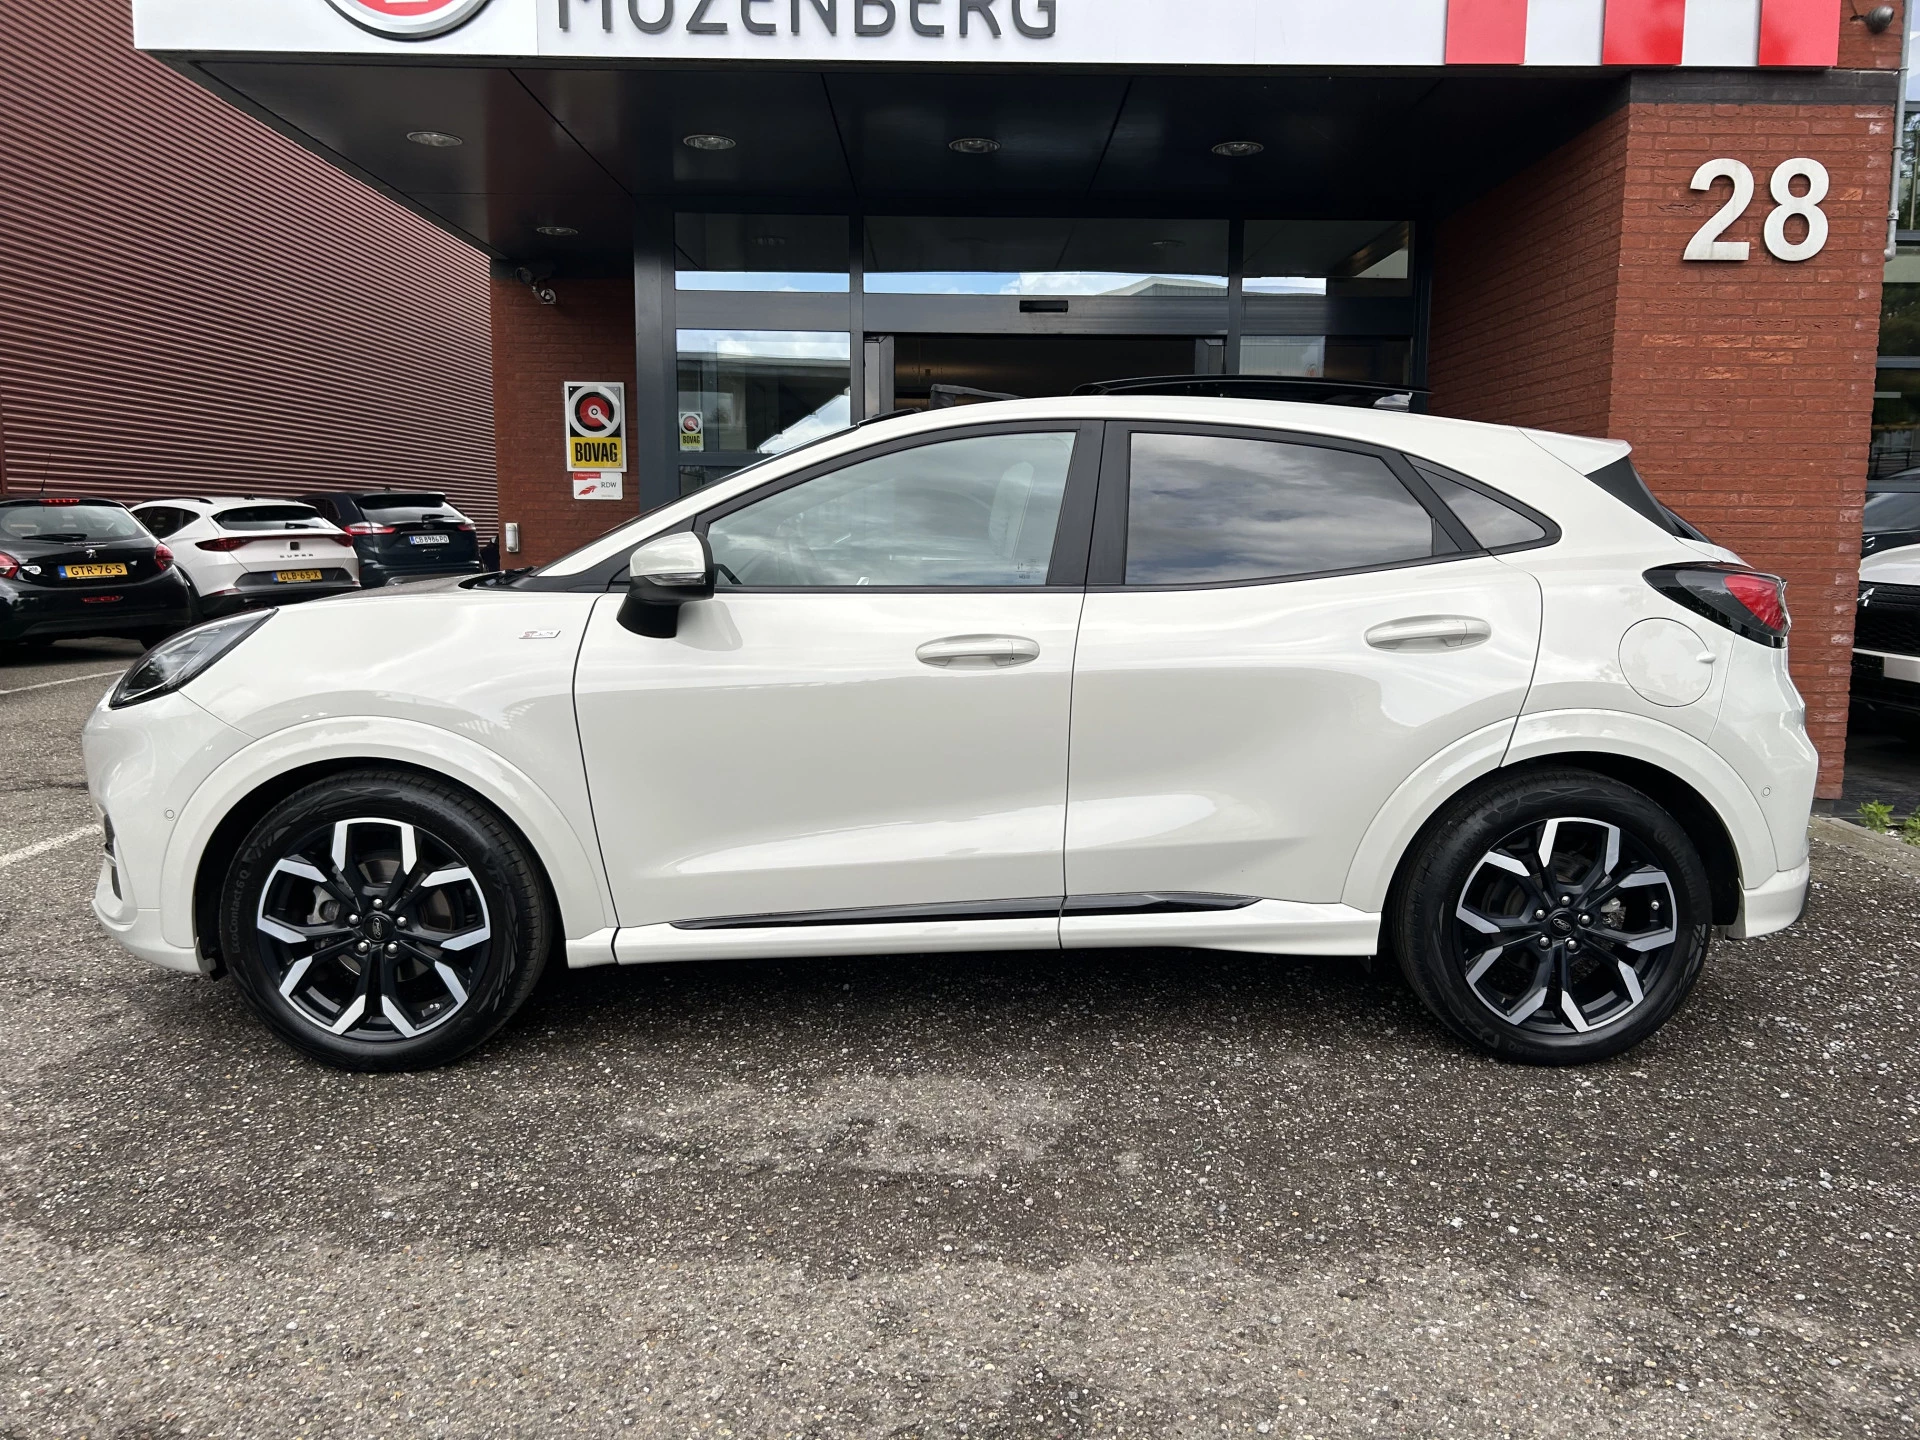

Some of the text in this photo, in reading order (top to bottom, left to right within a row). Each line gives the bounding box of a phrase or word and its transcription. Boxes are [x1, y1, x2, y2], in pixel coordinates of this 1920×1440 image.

[1682, 157, 1830, 263] 28
[682, 435, 701, 445] BOVAG
[574, 442, 618, 463] BOVAG
[600, 481, 617, 489] RDW
[70, 564, 123, 576] GTR-76-S
[280, 570, 320, 580] GLB-65-X
[228, 889, 244, 954] EcoContact
